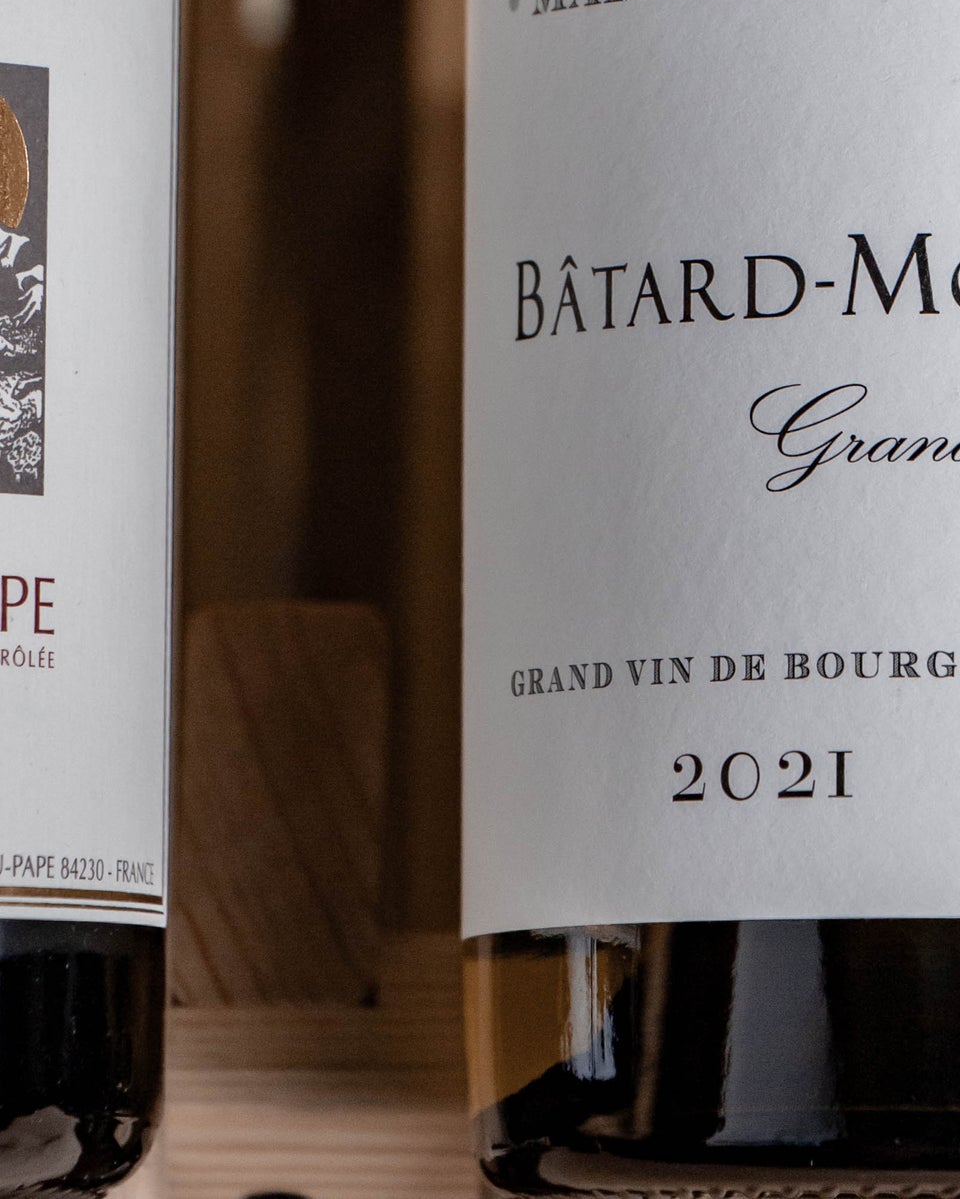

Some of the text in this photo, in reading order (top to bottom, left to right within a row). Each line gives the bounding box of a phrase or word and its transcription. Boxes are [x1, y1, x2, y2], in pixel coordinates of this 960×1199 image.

[0, 645, 55, 669] RÔLÉE
[510, 662, 613, 698] GRAND
[625, 656, 695, 687] VIN
[710, 653, 766, 683] DE
[671, 750, 854, 803] 2021
[60, 856, 104, 882] 84230
[116, 859, 155, 886] FRANCE
